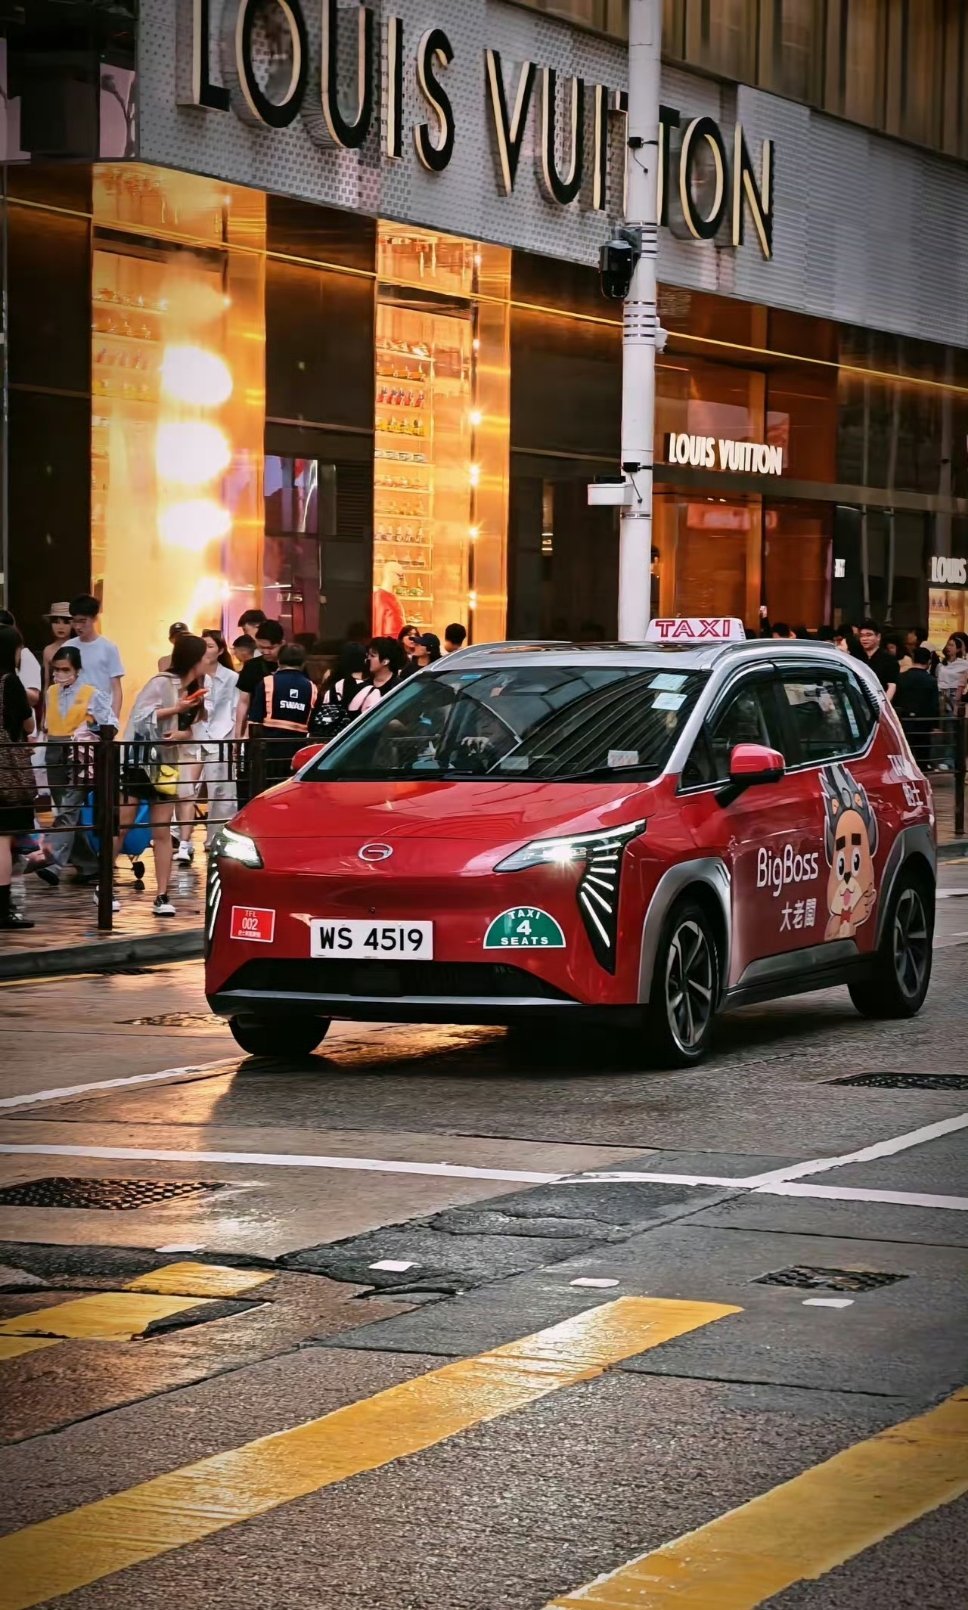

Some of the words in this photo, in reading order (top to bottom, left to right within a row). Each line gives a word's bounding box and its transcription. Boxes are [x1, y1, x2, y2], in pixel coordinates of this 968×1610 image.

[190, 0, 455, 172] LOUIS
[668, 432, 715, 468] LOUIS
[718, 439, 783, 476] VUITTON
[931, 556, 967, 584] LOUIS
[655, 619, 731, 637] TAXI
[756, 844, 819, 897] BigBoss
[241, 917, 259, 931] 002
[507, 909, 541, 920] TAXI
[516, 919, 532, 936] 4
[319, 926, 353, 950] WS
[363, 927, 424, 952] 4519
[500, 936, 549, 945] SEATS
